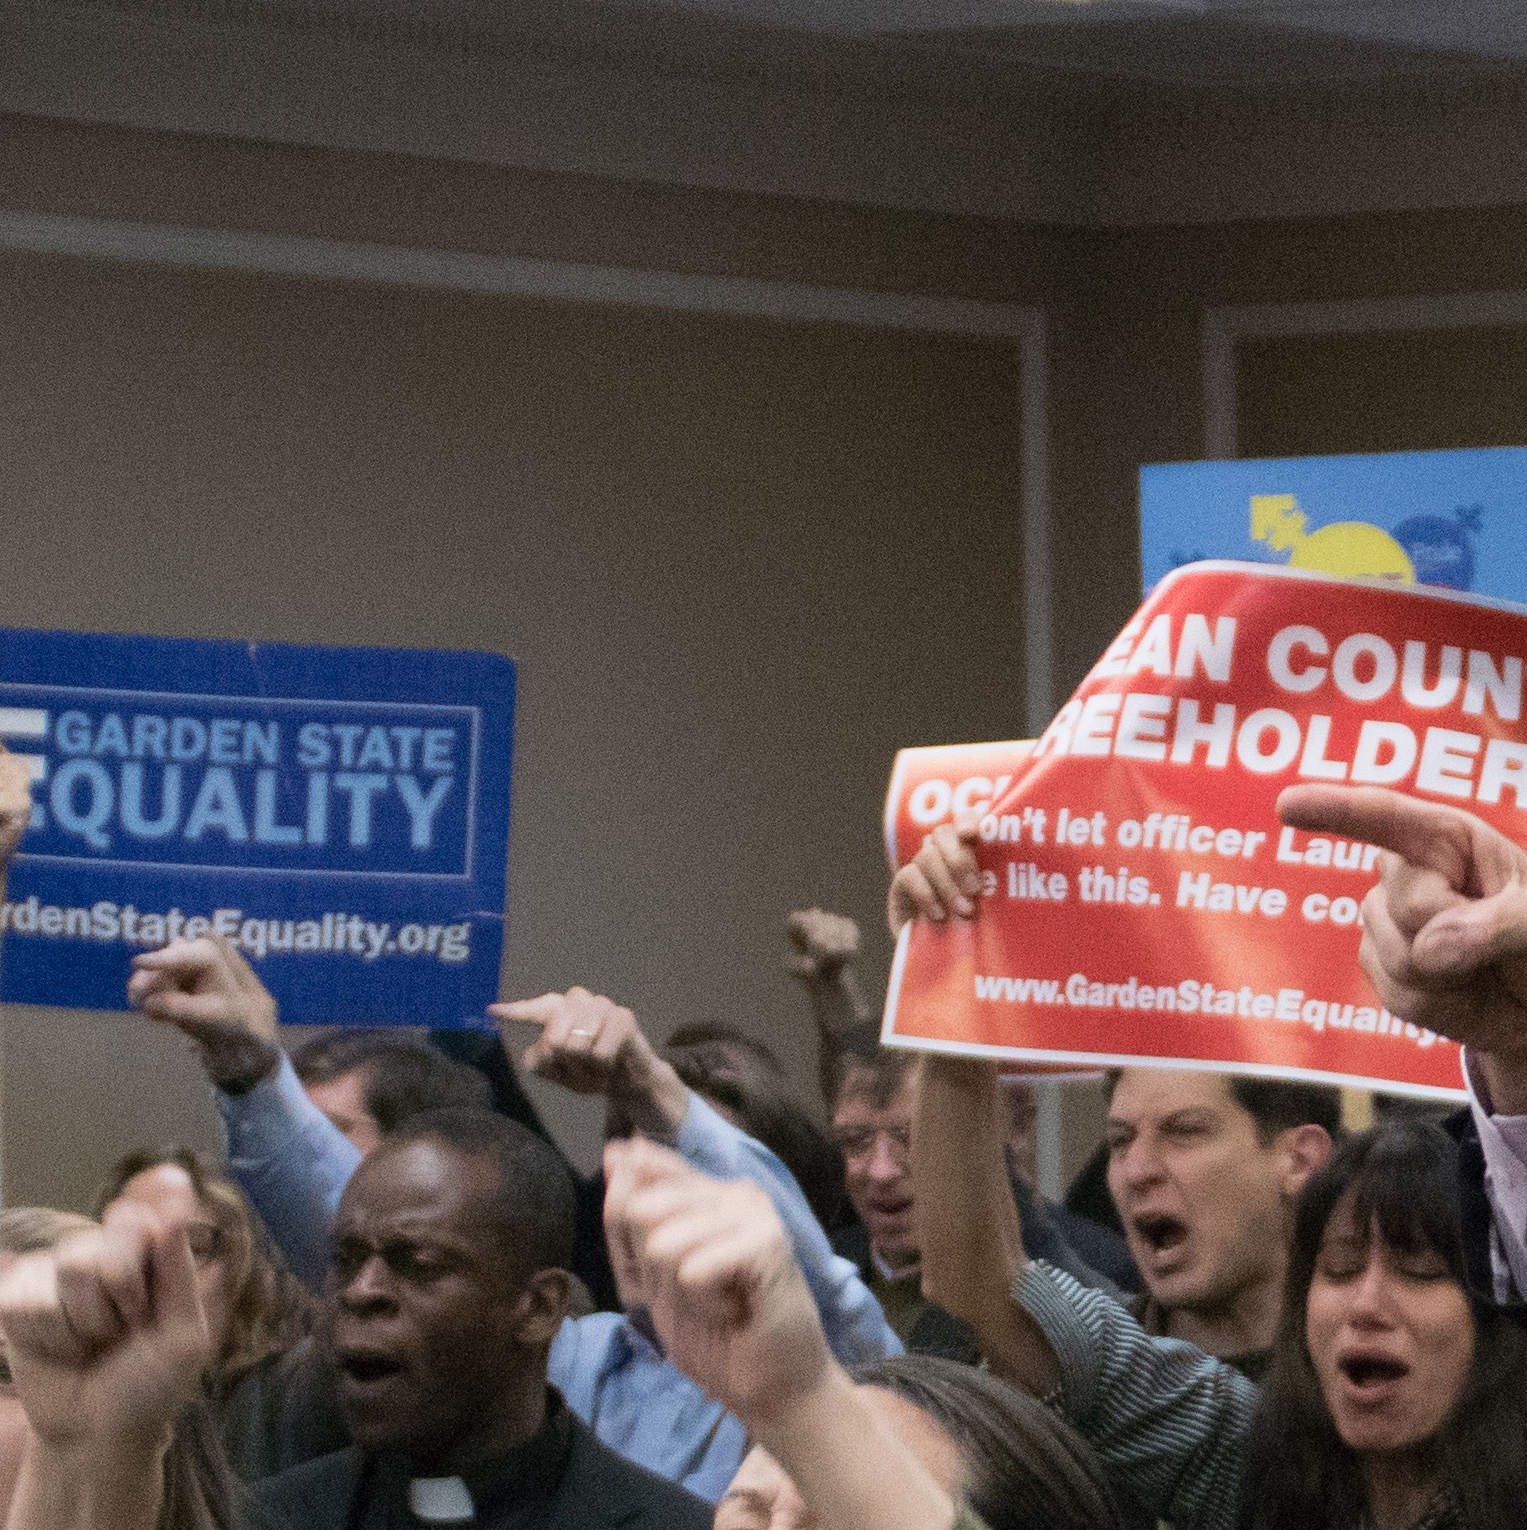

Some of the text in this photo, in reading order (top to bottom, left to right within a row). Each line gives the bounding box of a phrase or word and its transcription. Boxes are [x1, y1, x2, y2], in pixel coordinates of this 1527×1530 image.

[54, 709, 456, 773] GARDEN STATE
[1056, 807, 1108, 846] let
[1116, 813, 1267, 859] officer
[1007, 862, 1068, 901] like
[1078, 865, 1161, 906] this.
[1175, 870, 1289, 917] Have
